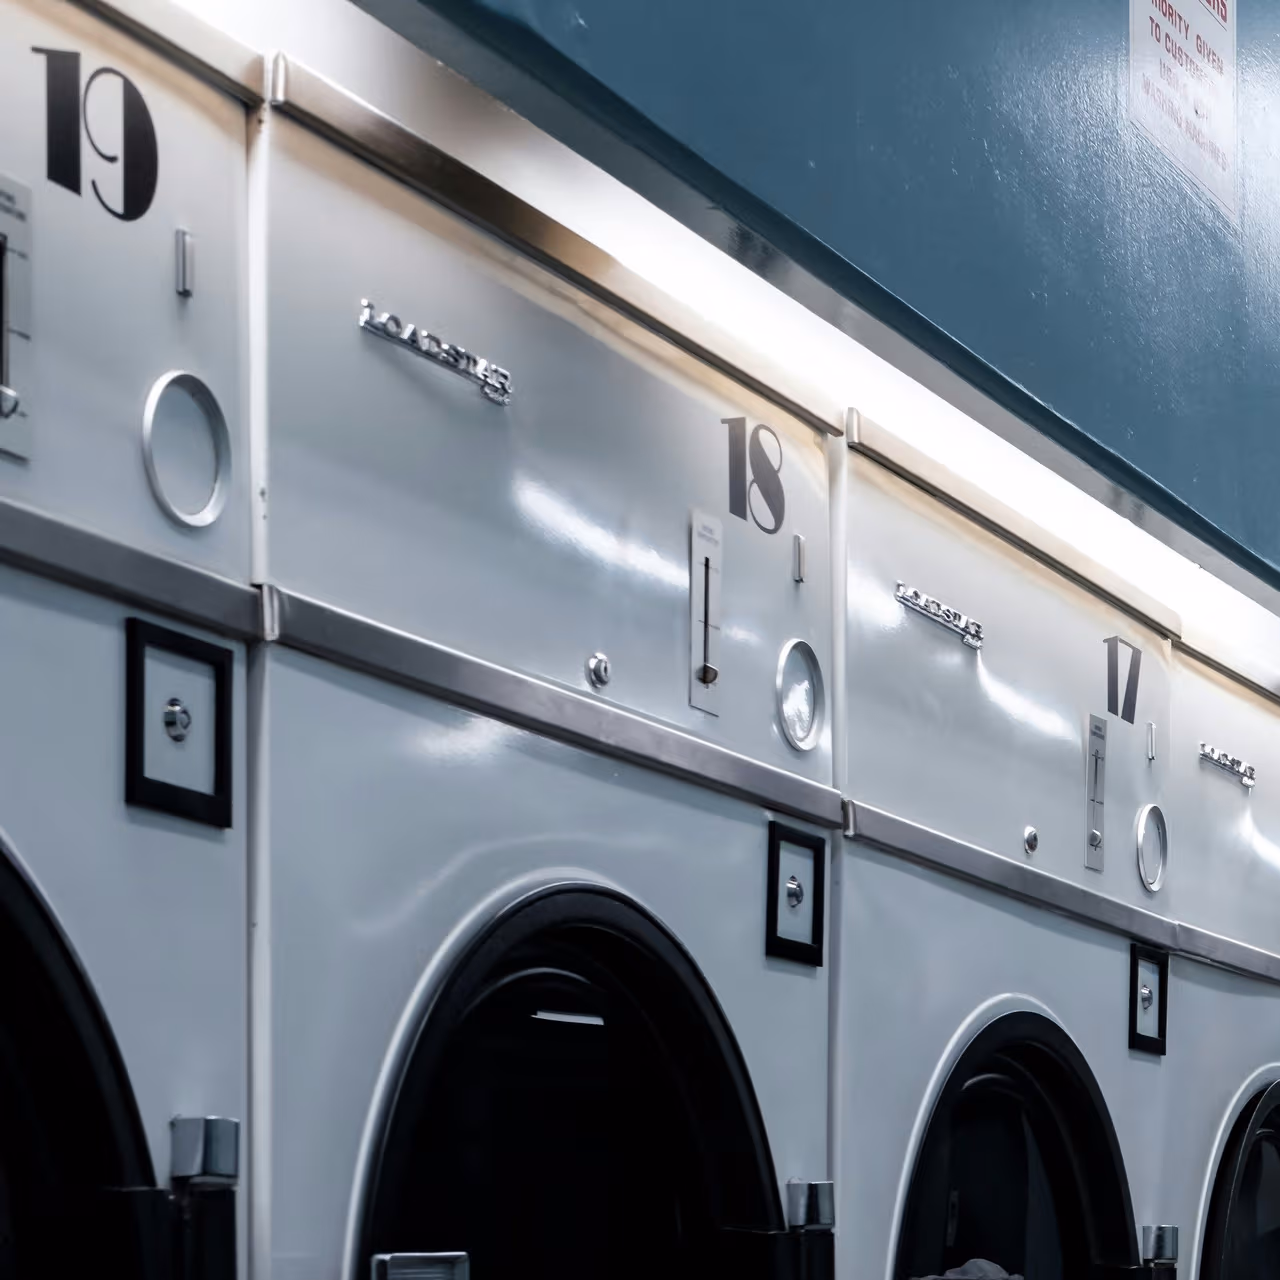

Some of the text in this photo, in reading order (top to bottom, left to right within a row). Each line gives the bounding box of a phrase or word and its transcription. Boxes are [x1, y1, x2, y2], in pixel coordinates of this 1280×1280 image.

[1149, 15, 1161, 43] TO
[1196, 34, 1225, 76] GIVEN
[31, 46, 158, 222] 19
[720, 416, 786, 535] 18
[1102, 635, 1142, 725] 17
